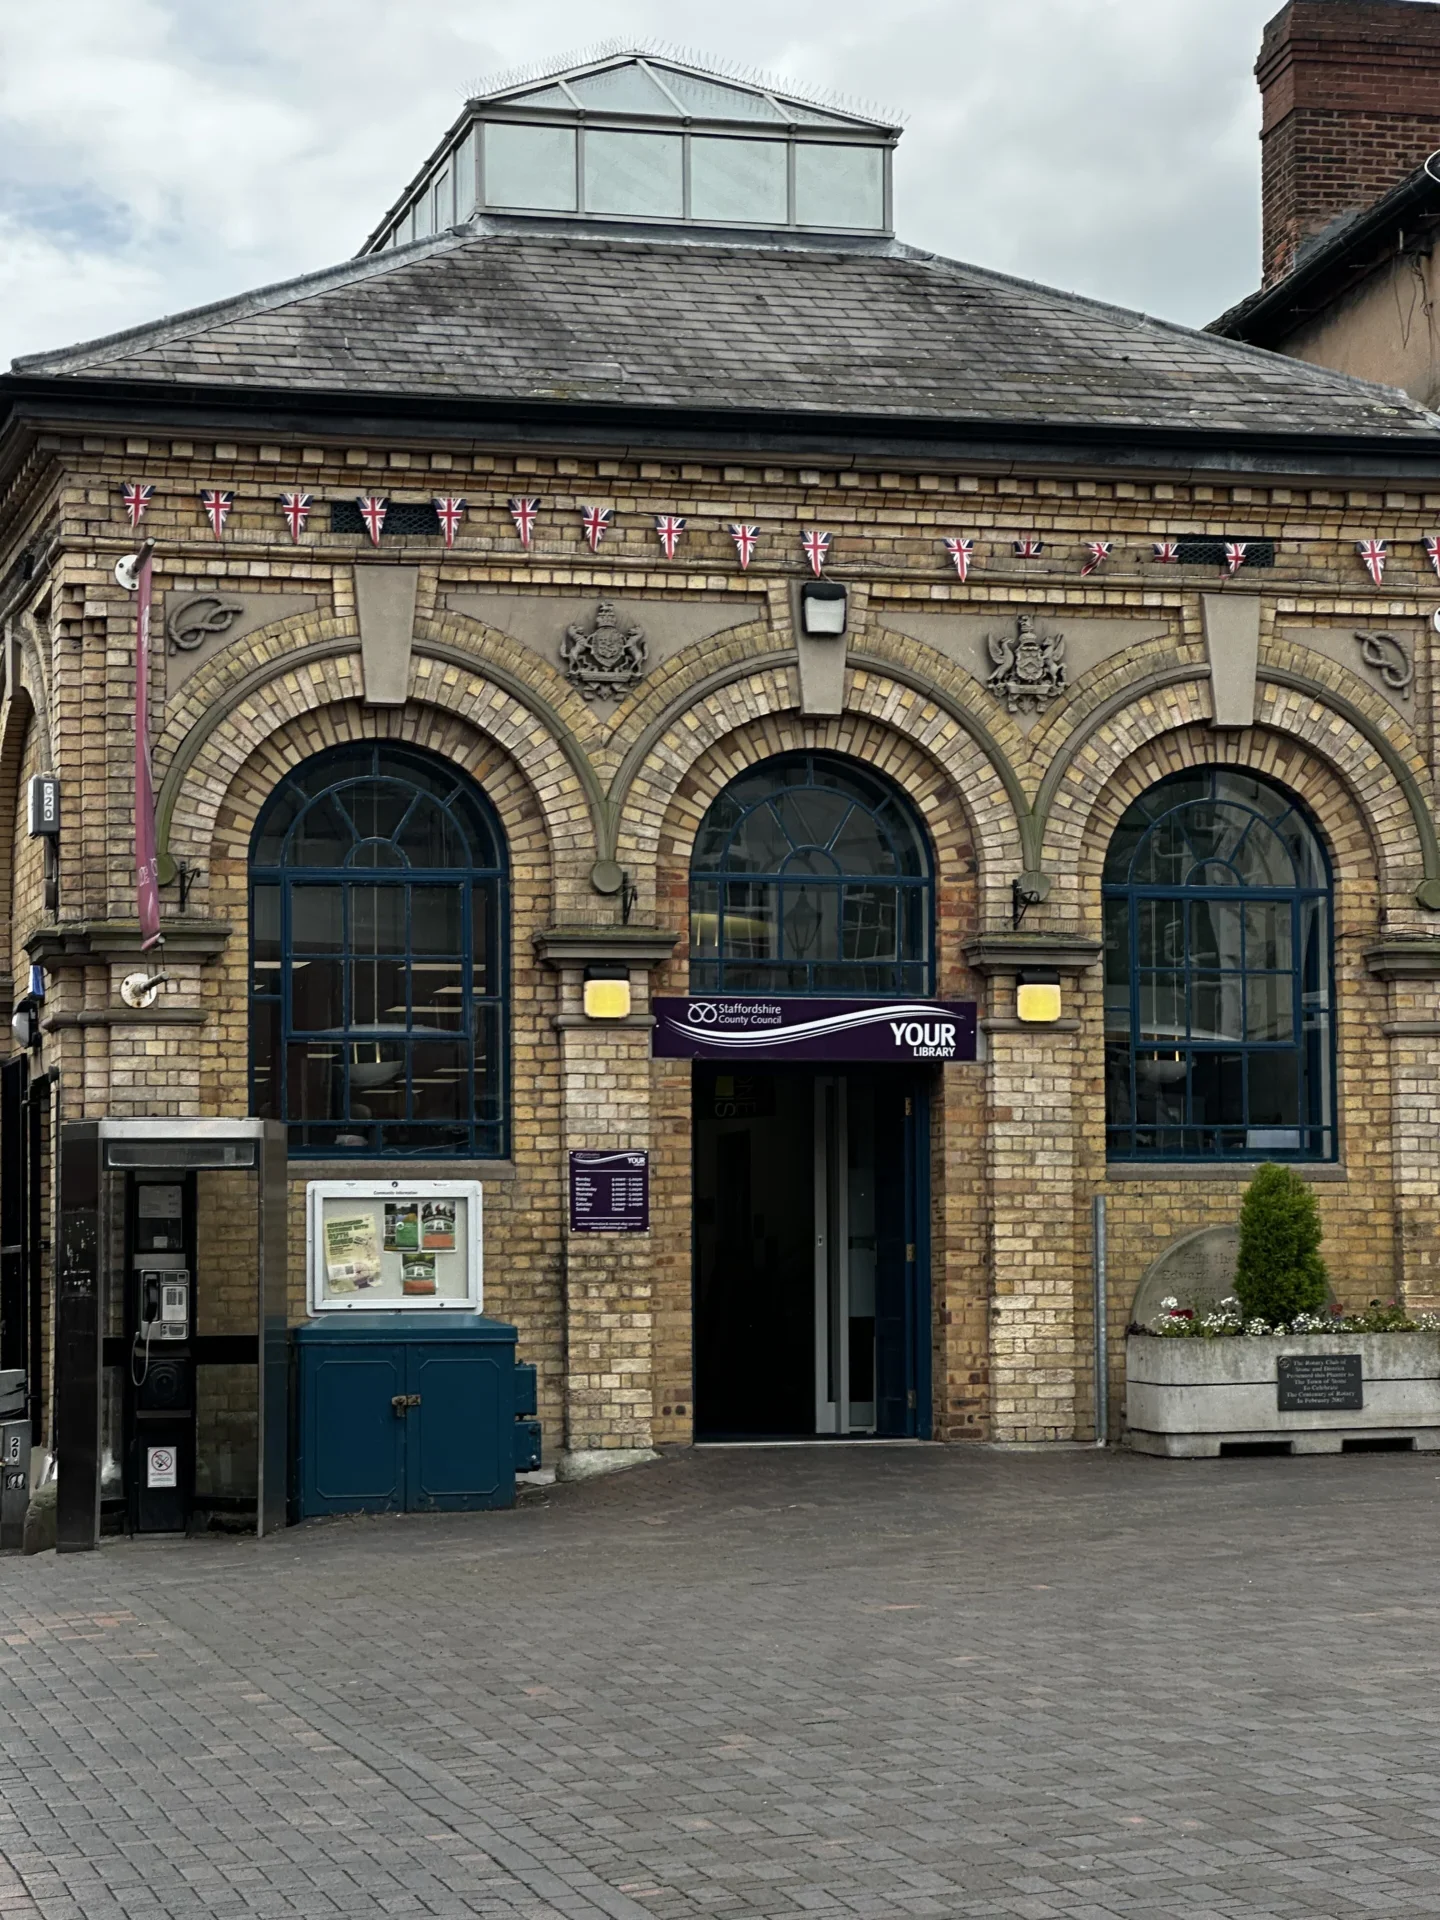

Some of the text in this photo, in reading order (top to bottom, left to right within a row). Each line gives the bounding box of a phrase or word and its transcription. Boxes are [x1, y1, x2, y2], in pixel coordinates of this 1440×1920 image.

[718, 1003, 782, 1015] Staffordshire
[718, 1014, 782, 1026] County Council
[890, 1022, 956, 1047] YOUR
[913, 1046, 955, 1057] LIBRARY
[12, 1438, 19, 1458] 20
